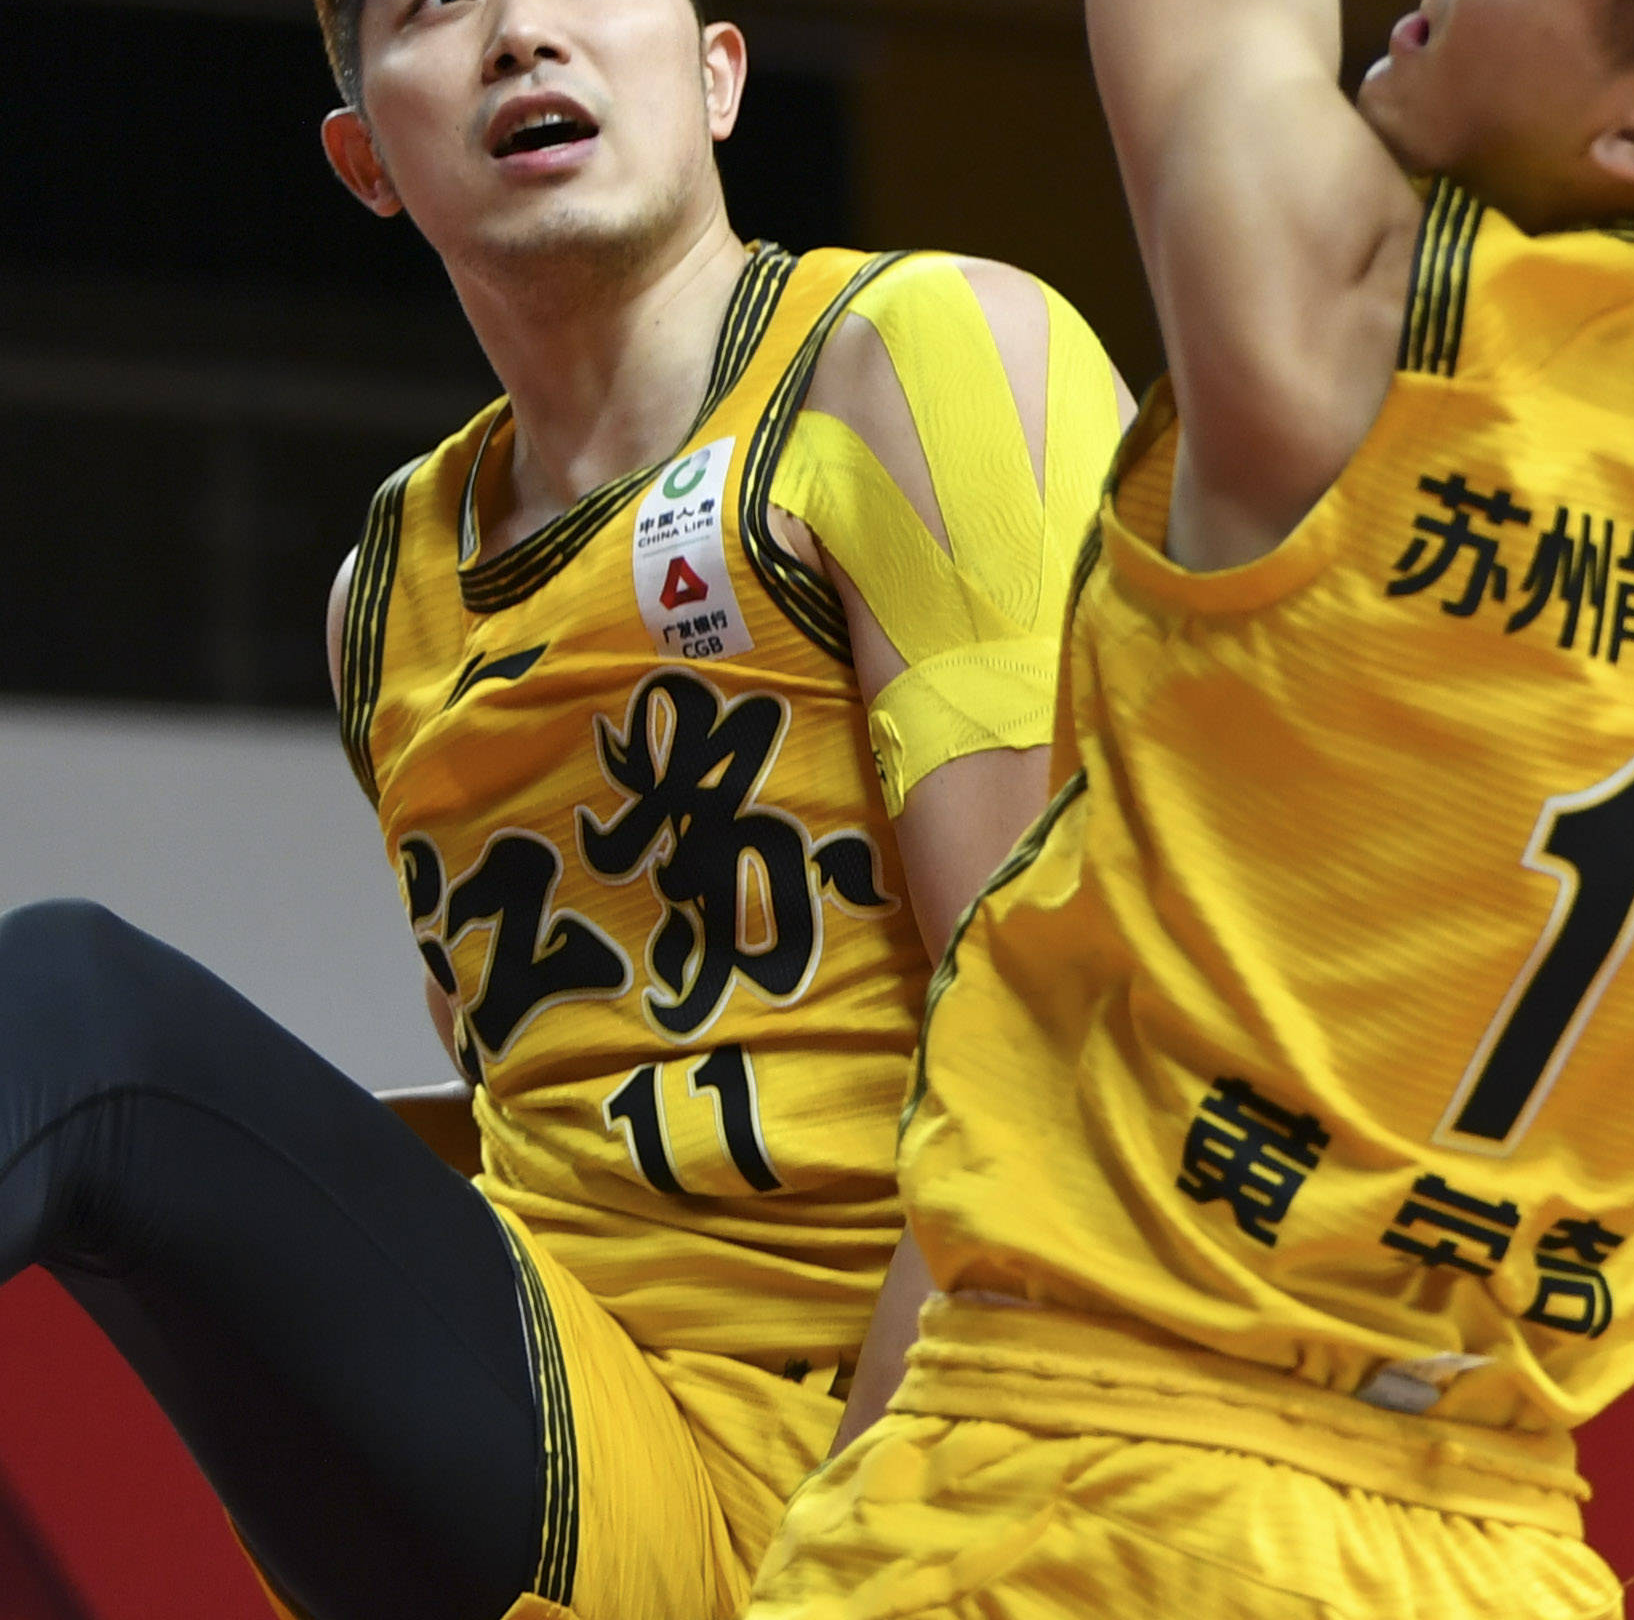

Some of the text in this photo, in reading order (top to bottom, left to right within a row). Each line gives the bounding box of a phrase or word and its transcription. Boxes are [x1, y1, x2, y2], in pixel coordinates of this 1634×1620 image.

[638, 516, 714, 548] CHINA LIFE
[639, 497, 716, 533] 中国人寿
[662, 609, 729, 644] 广发银行
[682, 636, 725, 659] CGB
[602, 1044, 786, 1196] 11
